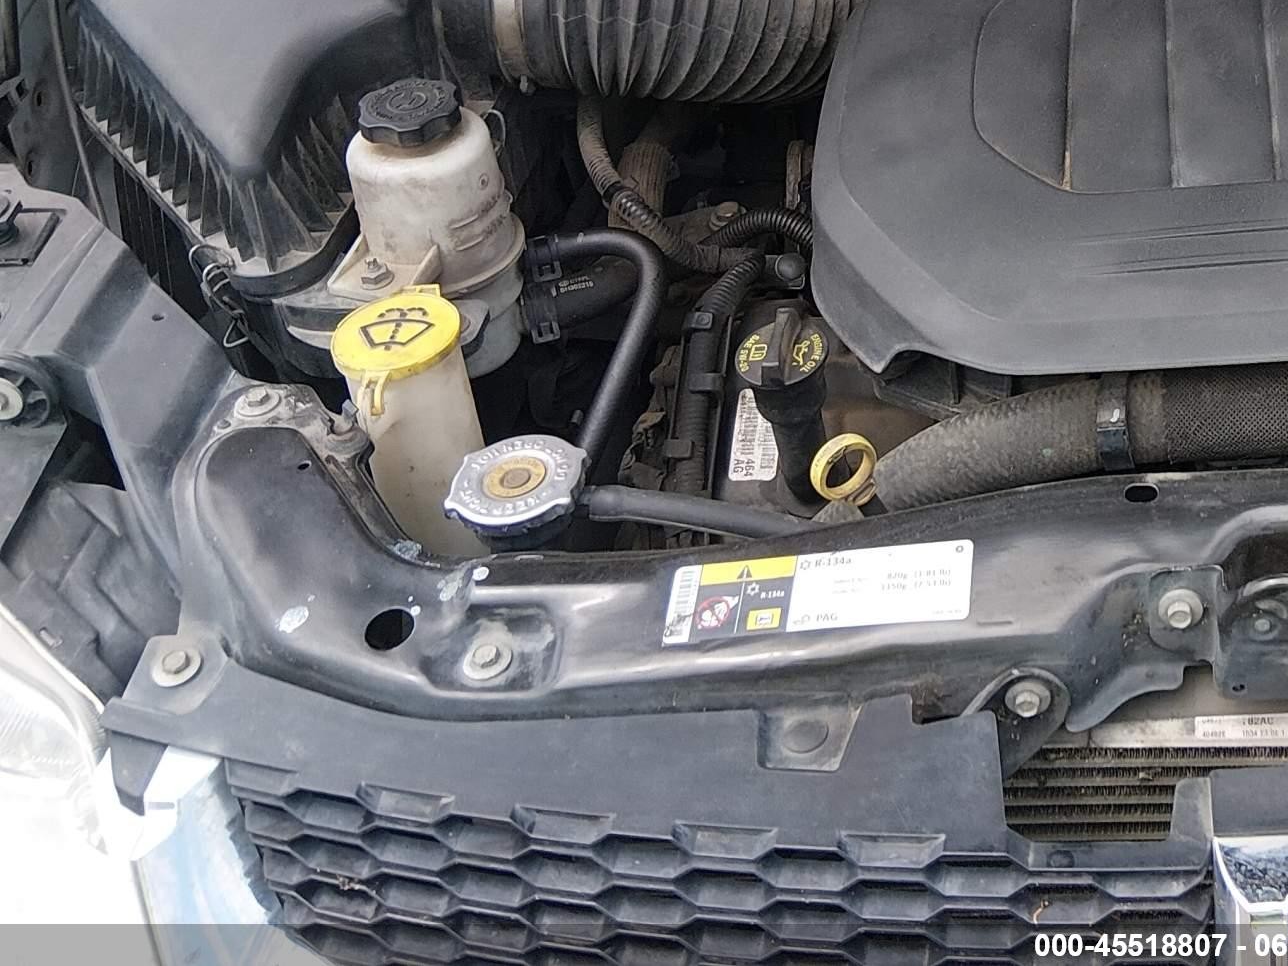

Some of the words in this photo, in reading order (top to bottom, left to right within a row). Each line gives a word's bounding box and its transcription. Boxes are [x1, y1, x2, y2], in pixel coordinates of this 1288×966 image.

[810, 333, 823, 361] ENGINE
[799, 360, 817, 373] OIL
[815, 556, 852, 569] R-134a
[815, 612, 839, 623] PAG
